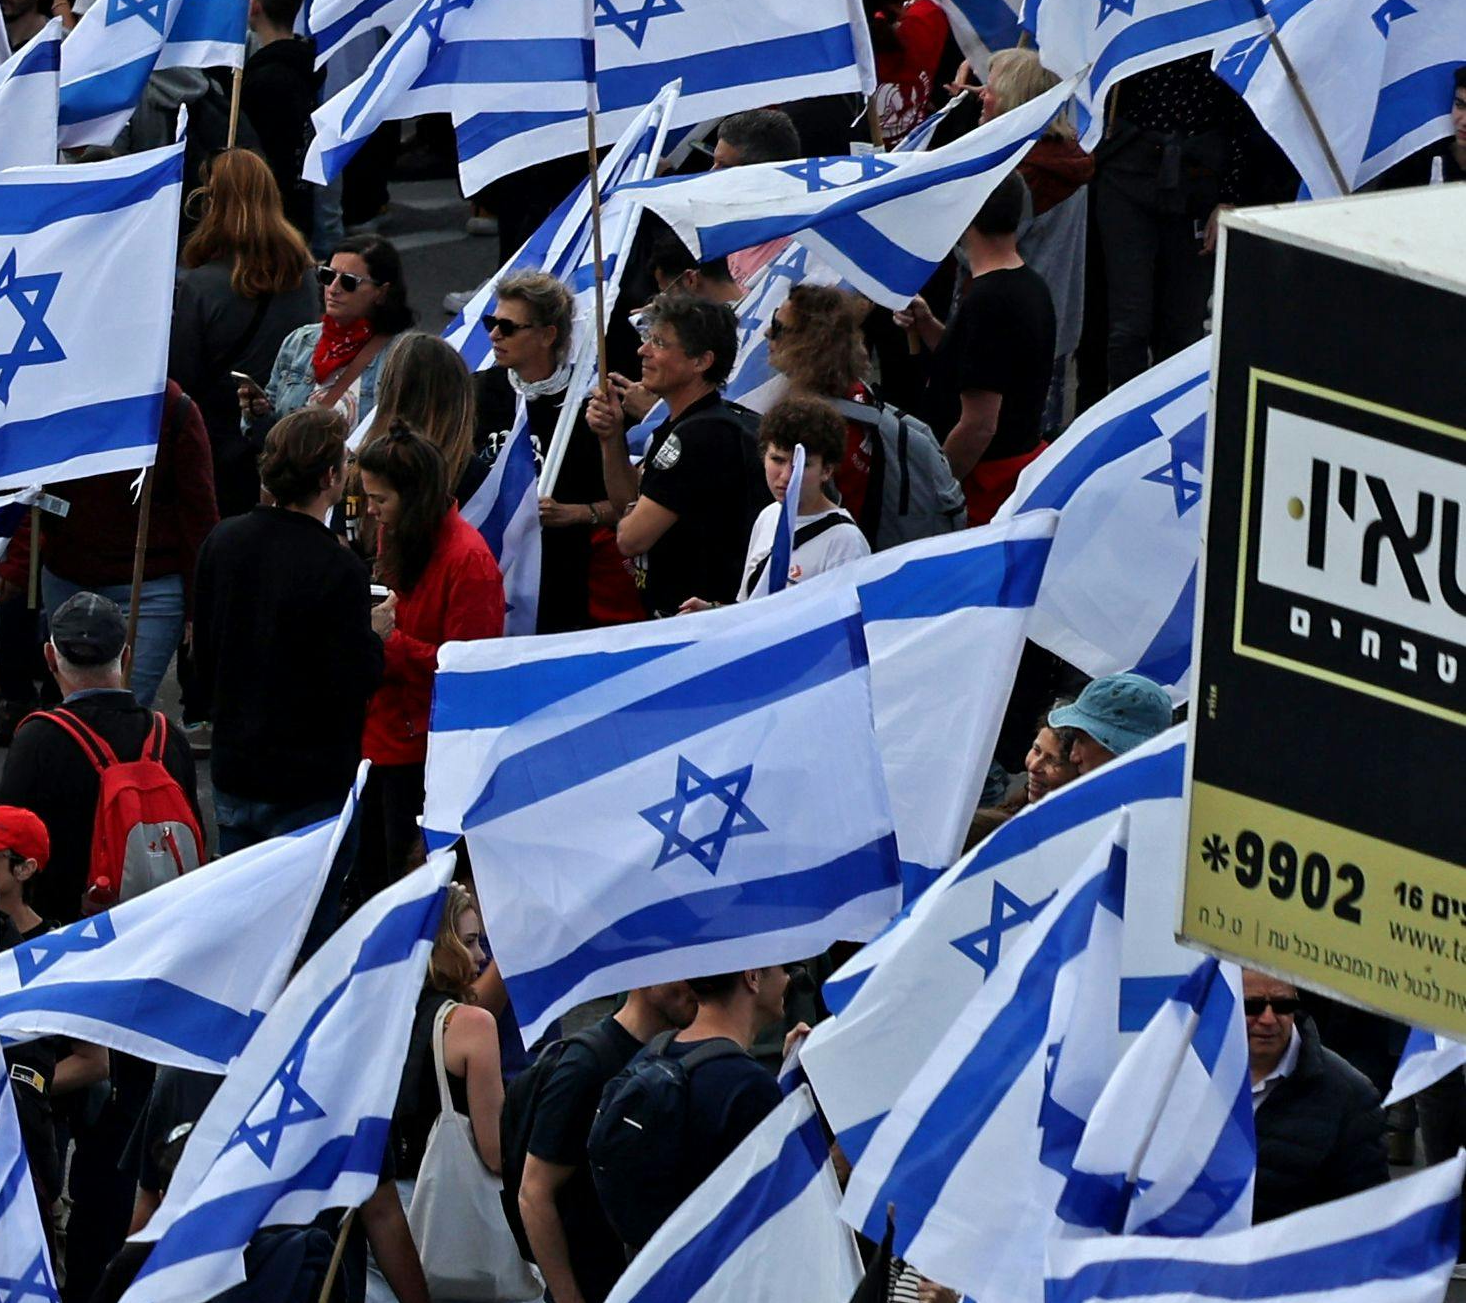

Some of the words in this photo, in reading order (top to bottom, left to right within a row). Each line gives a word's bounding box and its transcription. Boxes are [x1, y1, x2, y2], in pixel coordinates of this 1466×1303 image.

[1393, 880, 1424, 907] 16
[1293, 933, 1320, 963] בכל
[1324, 948, 1373, 979] המבצע
[1378, 967, 1400, 990] את
[1404, 972, 1441, 1003] לבטל
